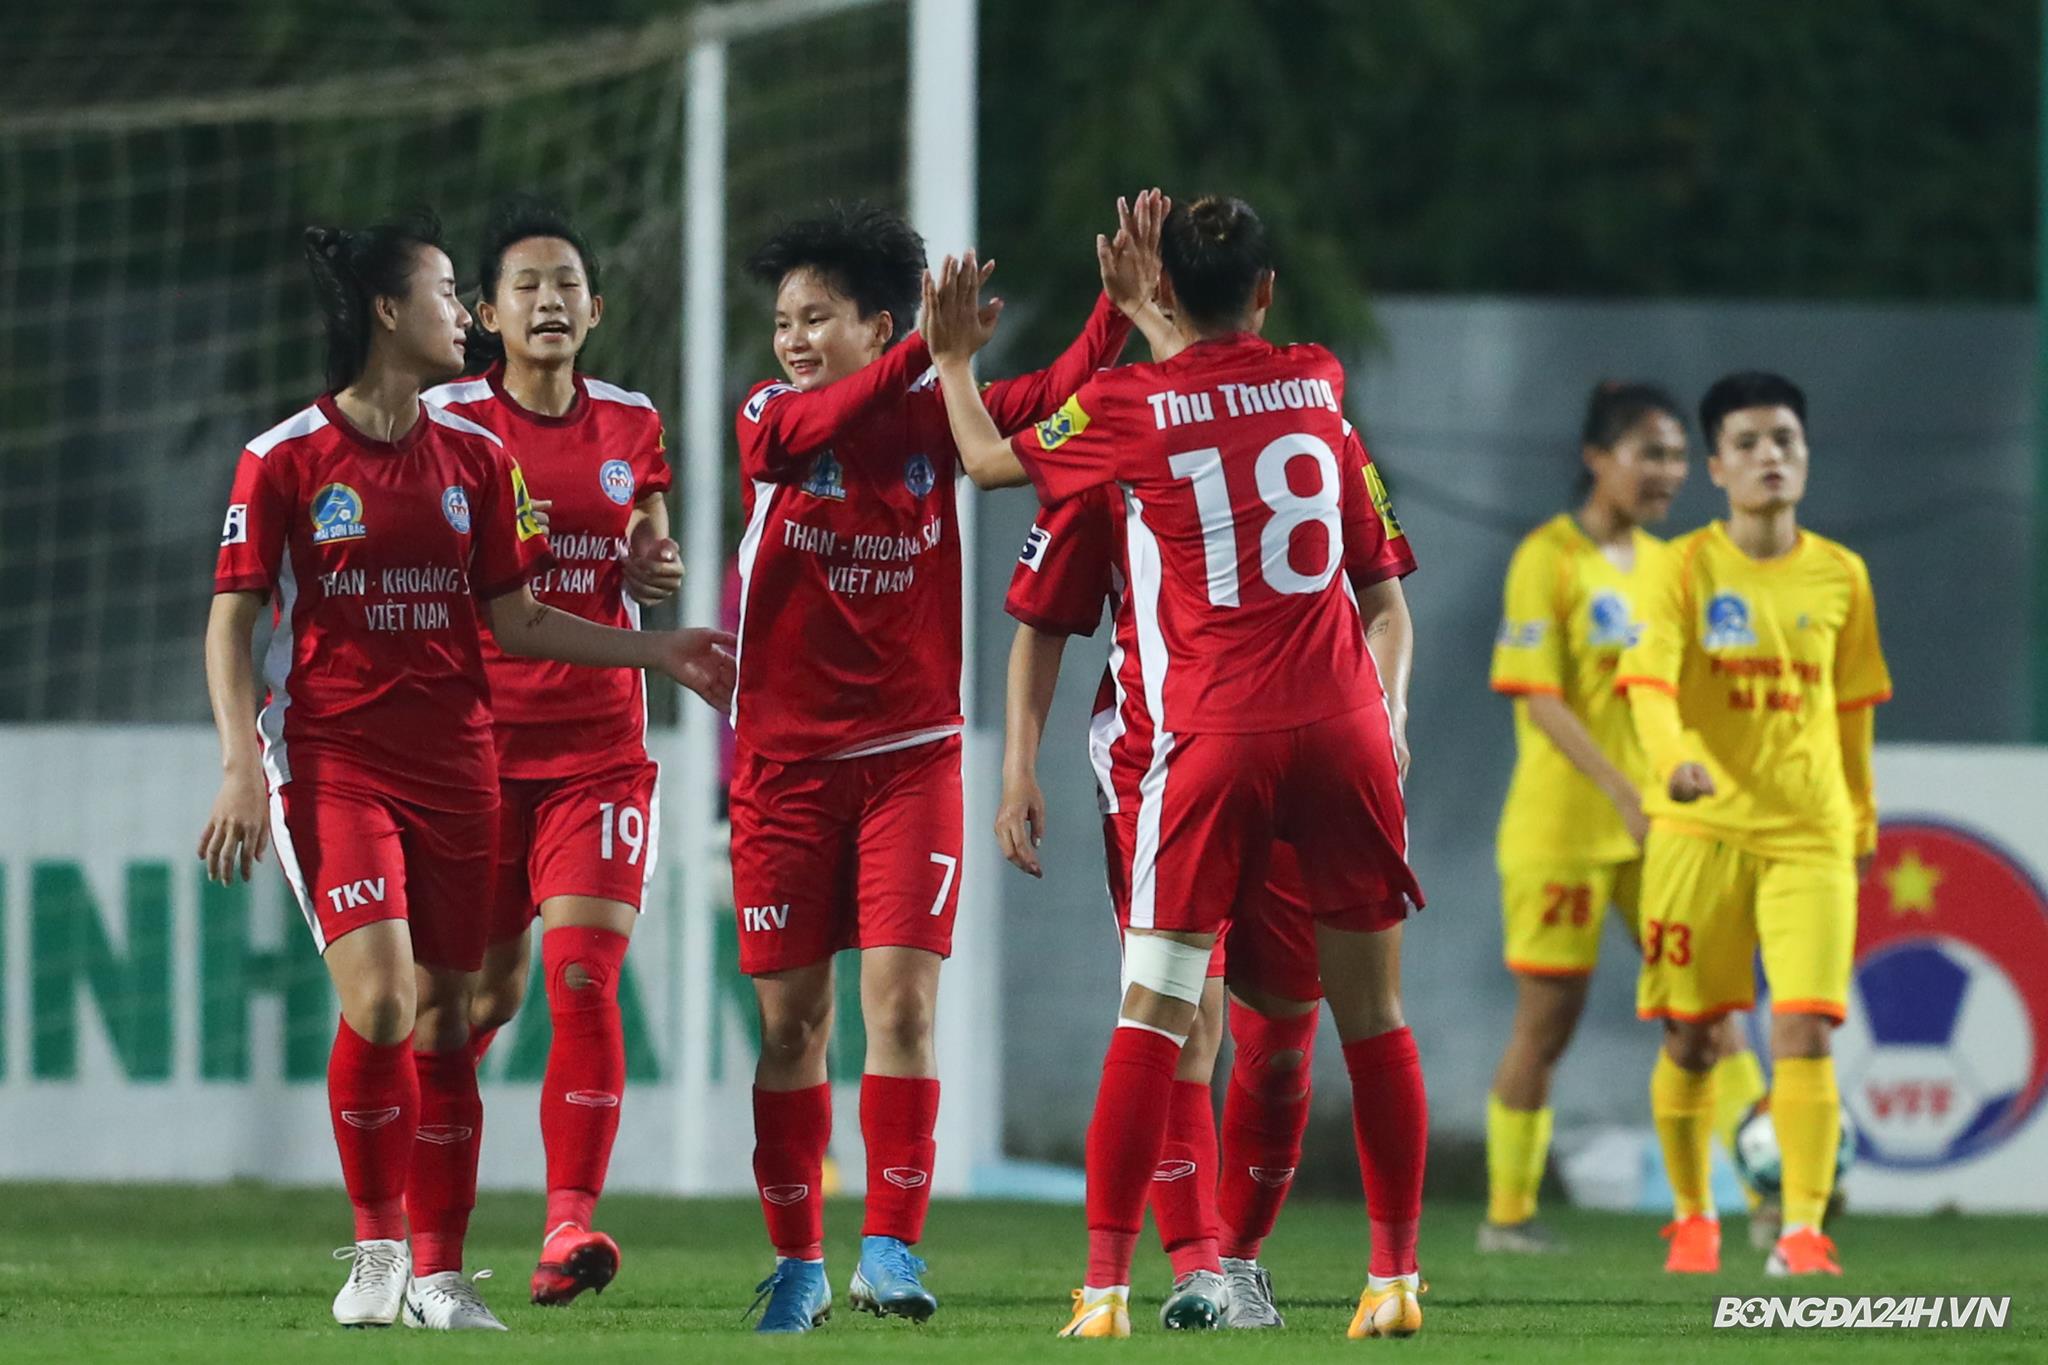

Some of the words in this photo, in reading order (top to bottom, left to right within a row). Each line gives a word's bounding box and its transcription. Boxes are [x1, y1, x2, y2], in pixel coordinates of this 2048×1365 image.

[1147, 390, 1214, 430] Thu
[1217, 377, 1338, 417] Thương
[784, 519, 836, 556] THAN
[1168, 433, 1344, 607] 18
[548, 529, 608, 560] HOÁNG
[381, 561, 459, 594] KHOÁNG
[556, 568, 596, 594] NAM
[829, 563, 872, 599] VIỆT
[874, 565, 914, 595] NAM
[365, 598, 407, 636] VIỆT
[413, 602, 449, 630] NAM
[599, 802, 644, 866] 19
[327, 877, 385, 913] TKV
[930, 852, 957, 916] 7
[743, 903, 789, 932] TKV
